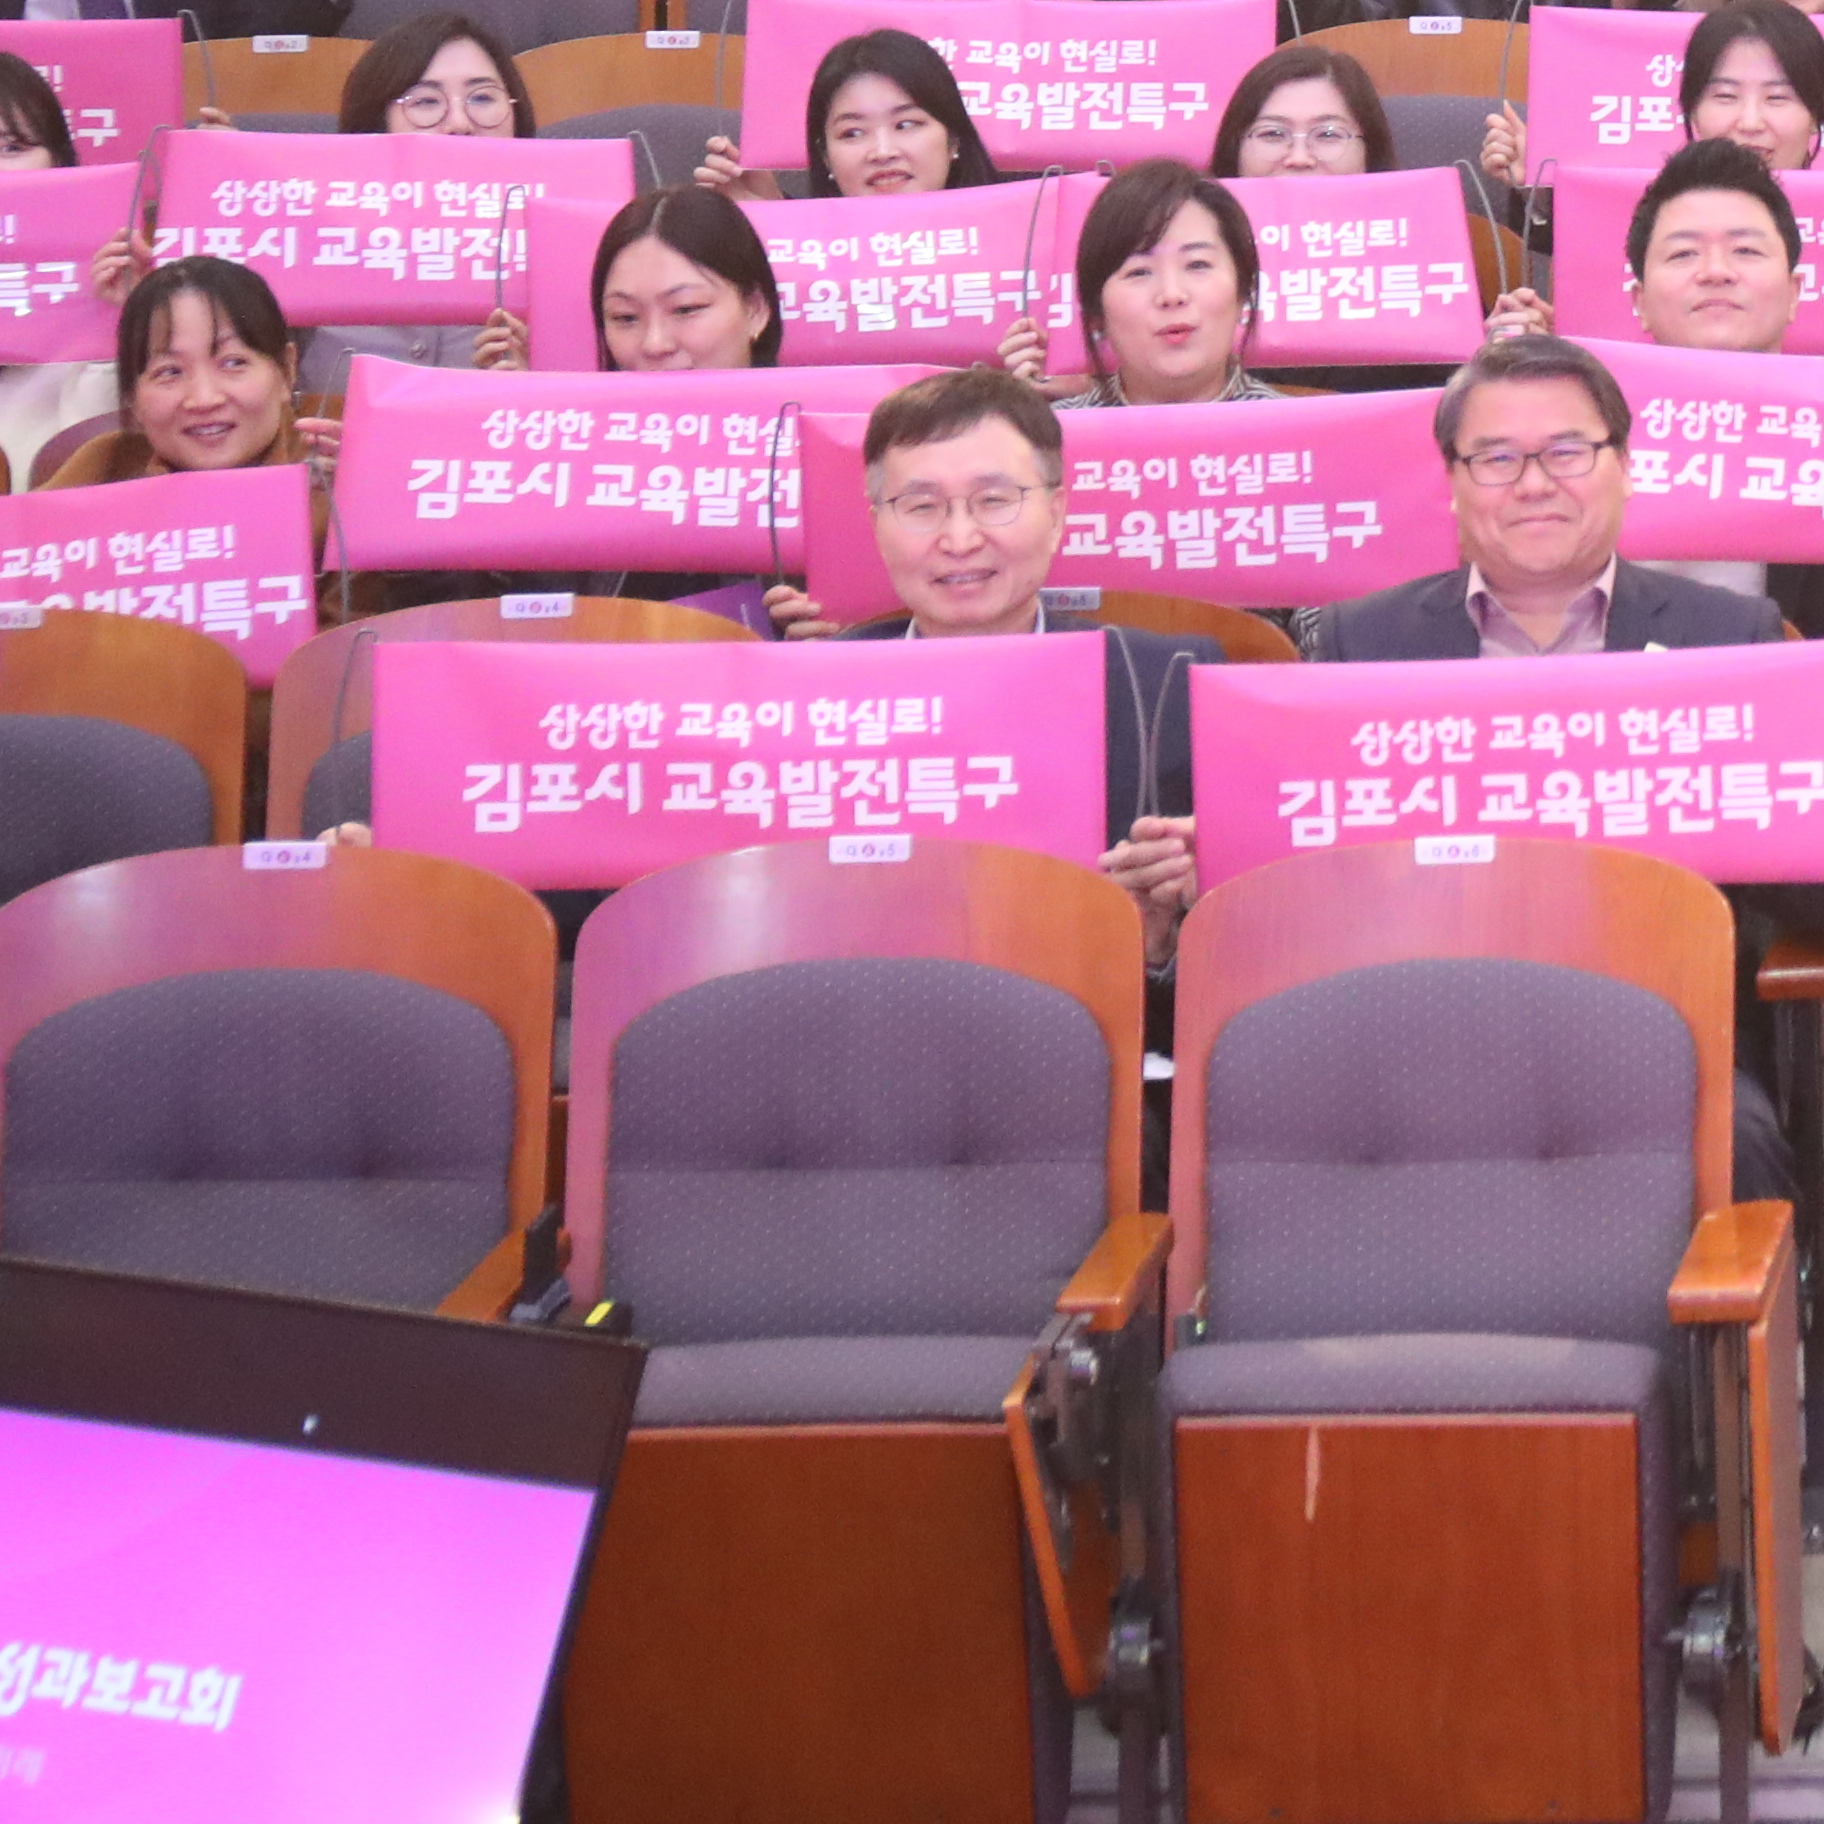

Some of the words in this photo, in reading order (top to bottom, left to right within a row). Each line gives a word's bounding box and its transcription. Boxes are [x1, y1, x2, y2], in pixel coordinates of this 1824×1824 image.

[1640, 397, 1747, 444] 상상한
[1628, 449, 1725, 500] 포시
[538, 699, 667, 751] 상상한
[675, 699, 796, 749] 교육이
[806, 695, 944, 747] 현실로!
[1350, 715, 1477, 767] 상상한
[1489, 711, 1607, 759] 교육이
[1618, 702, 1755, 756] 현실로!
[462, 762, 643, 833] 김포시
[662, 755, 1020, 829] 교육발전특구
[1278, 775, 1458, 847] 김포시
